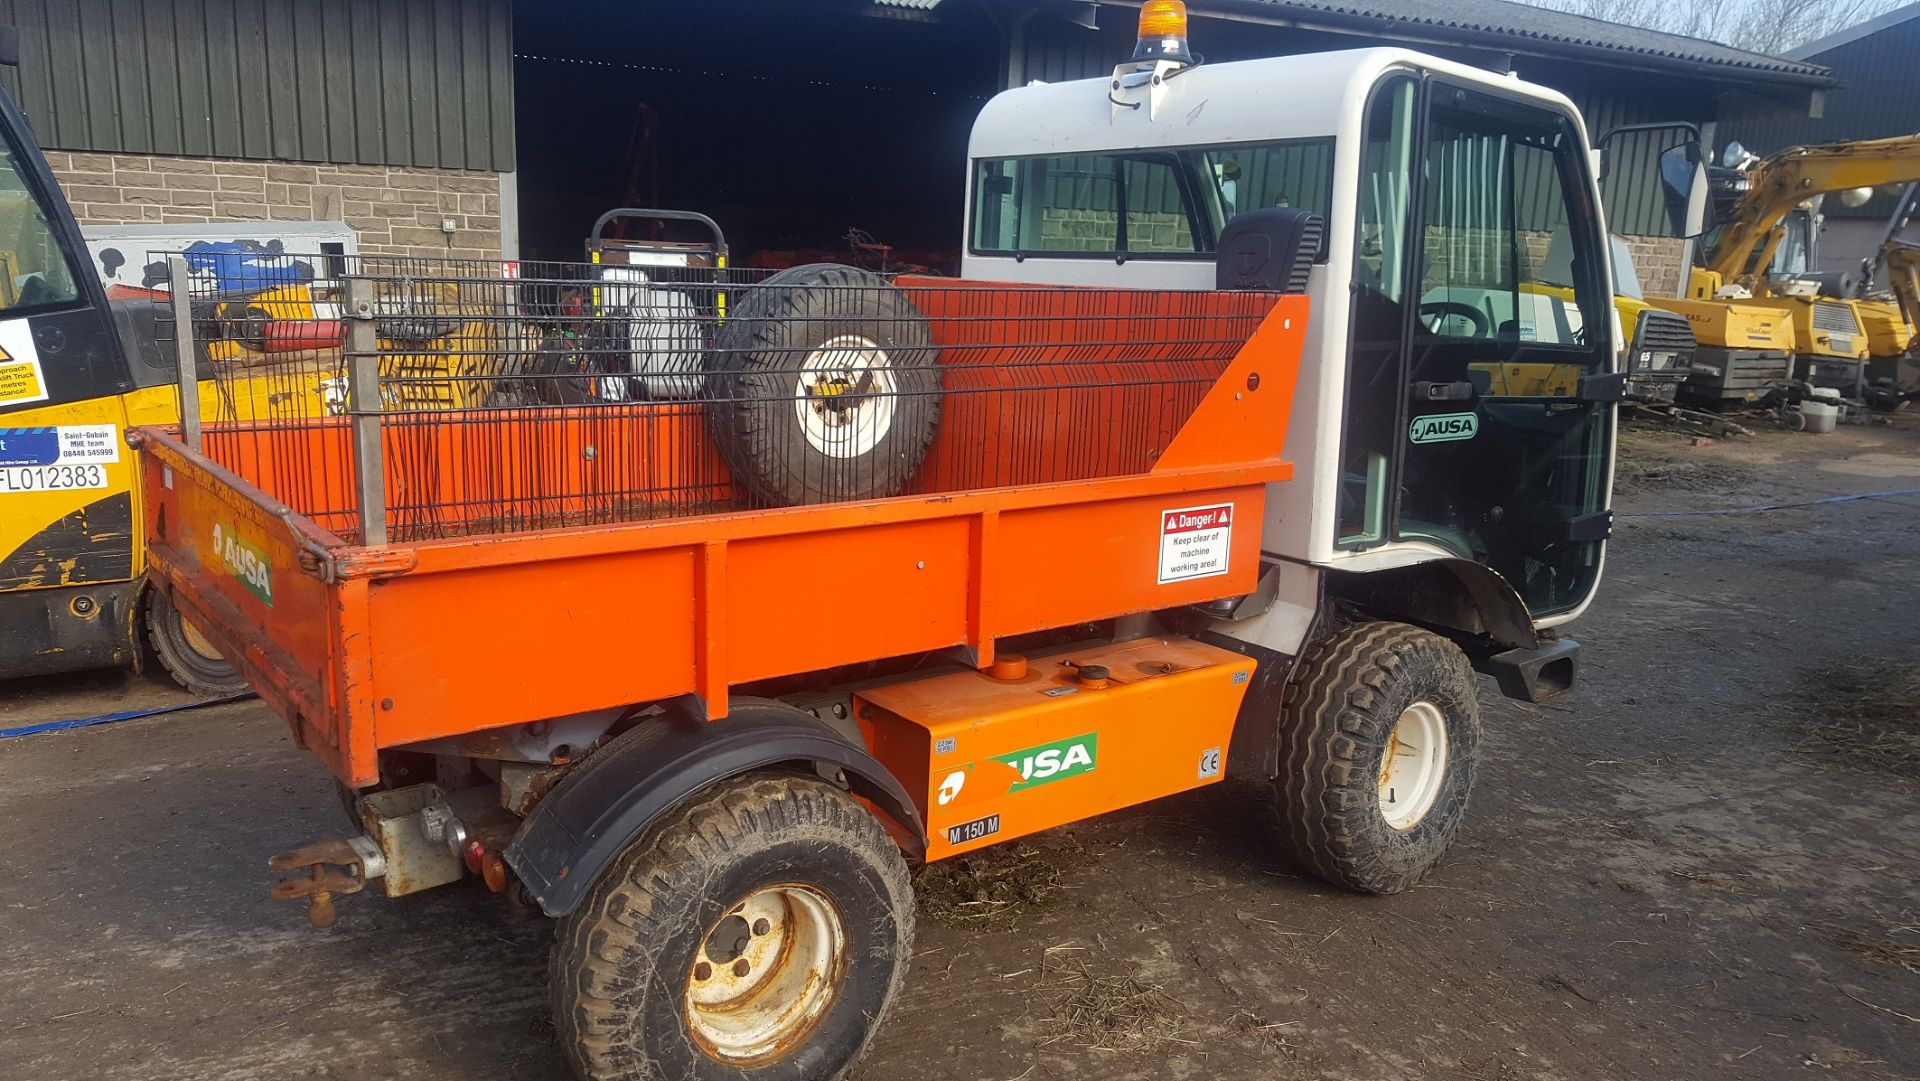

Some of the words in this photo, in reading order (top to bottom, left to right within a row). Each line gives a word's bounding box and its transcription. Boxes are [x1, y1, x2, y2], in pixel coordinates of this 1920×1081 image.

[1641, 352, 1650, 361] 65
[13, 371, 34, 379] Truck
[1, 381, 26, 389] metres
[1425, 420, 1473, 435] AUSA
[64, 431, 109, 439] Saint-Gobain
[1173, 537, 1192, 545] Keep
[1193, 534, 1210, 543] clear
[1211, 532, 1219, 541] of
[1180, 548, 1210, 558] machine
[224, 536, 271, 597] AUSA
[1170, 562, 1198, 573] working
[1199, 558, 1217, 569] area!
[1007, 743, 1093, 781] USA
[950, 827, 960, 844] M
[964, 821, 984, 840] 150
[987, 816, 998, 833] M
